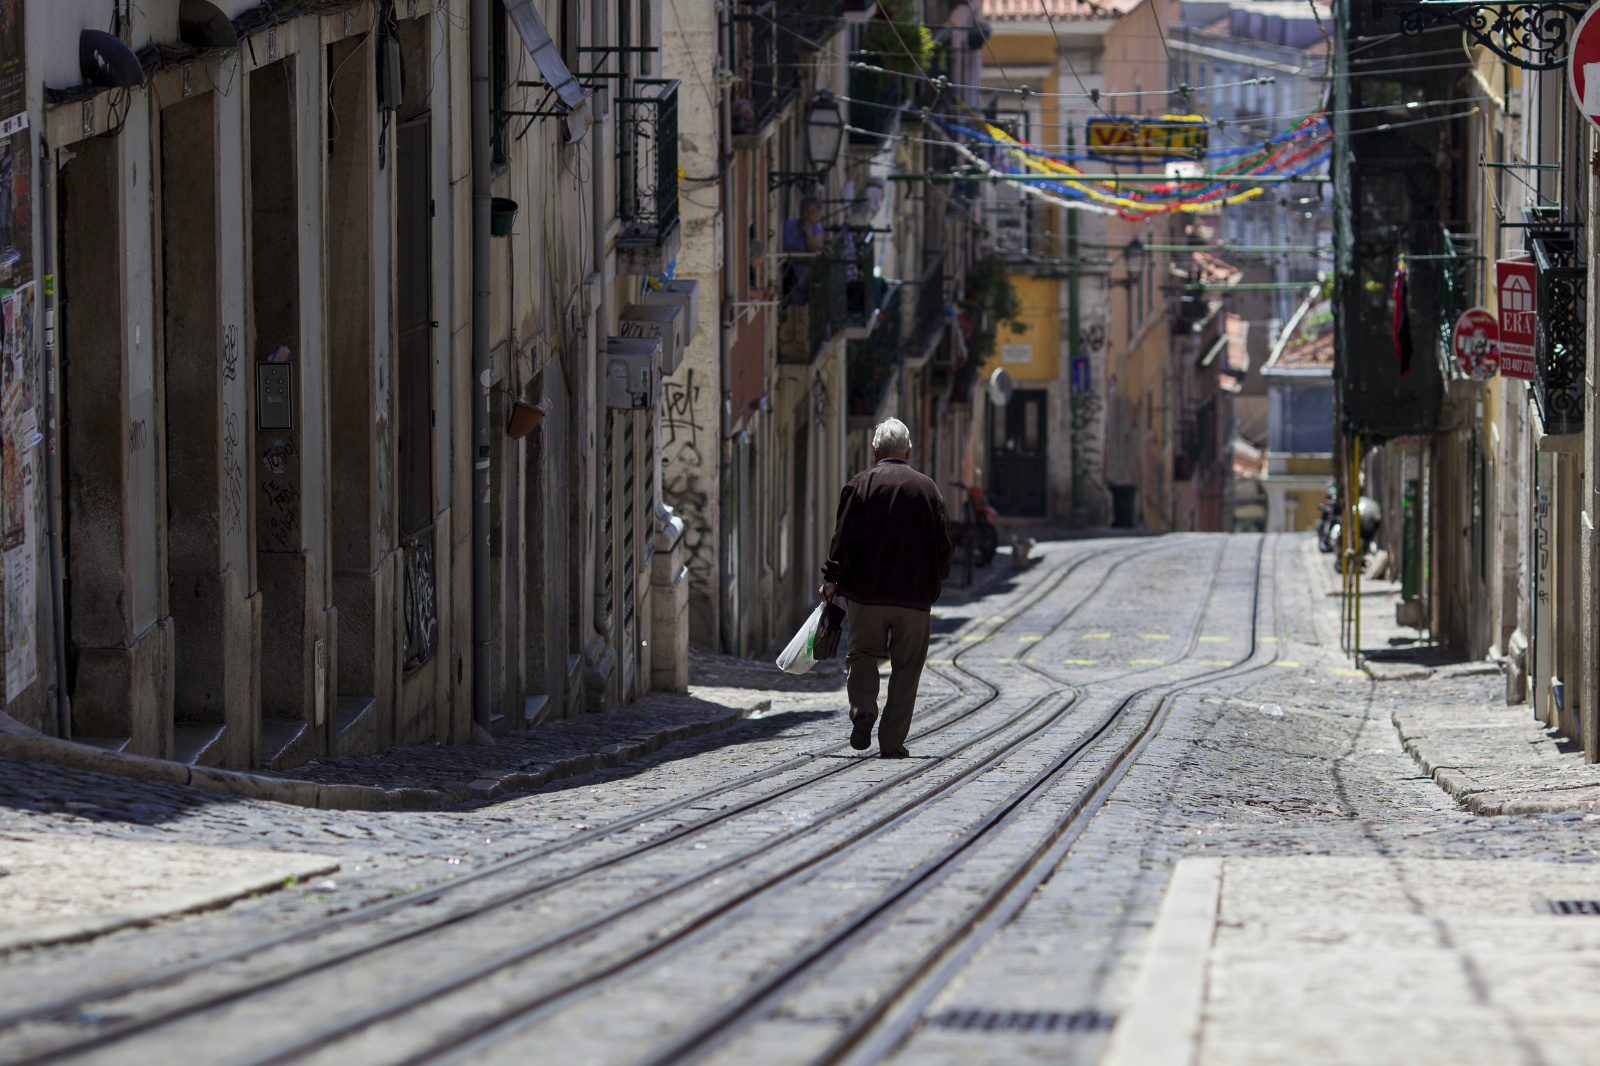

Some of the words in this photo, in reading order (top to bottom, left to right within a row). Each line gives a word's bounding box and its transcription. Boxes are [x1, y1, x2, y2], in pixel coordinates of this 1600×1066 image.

[1503, 311, 1532, 334] ERA
[1502, 357, 1511, 370] 213
[1523, 360, 1534, 374] 270
